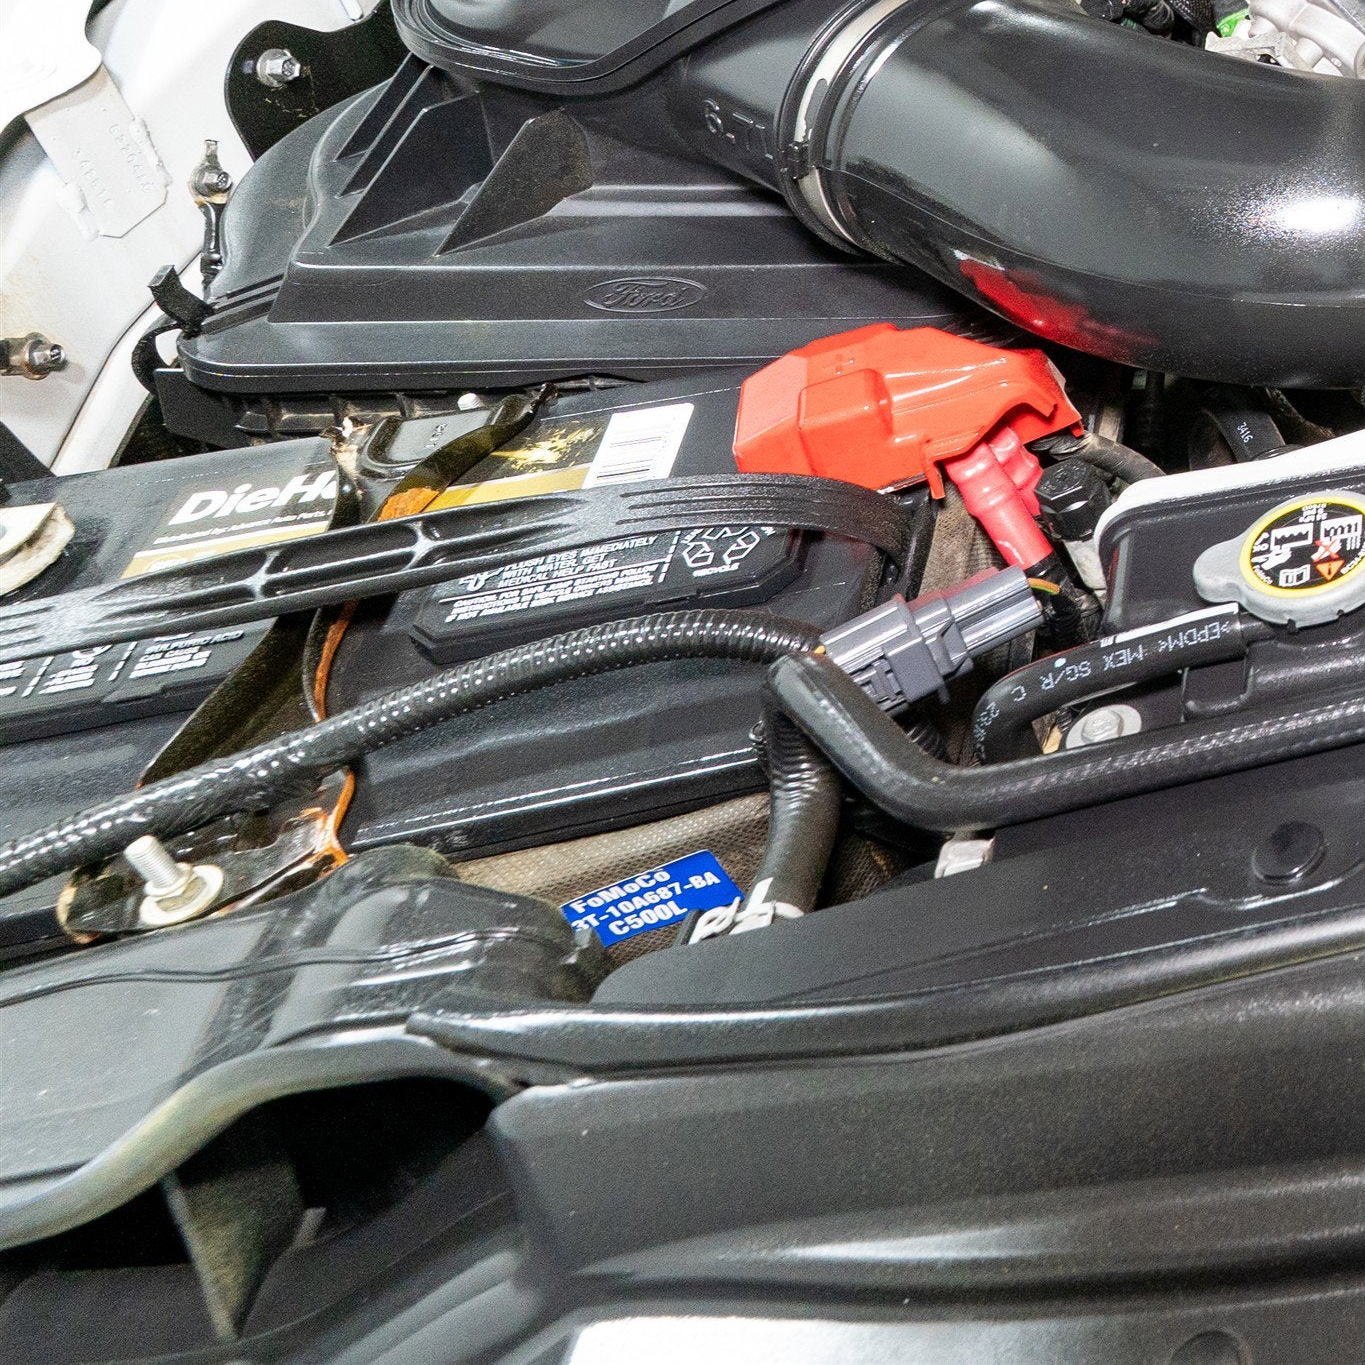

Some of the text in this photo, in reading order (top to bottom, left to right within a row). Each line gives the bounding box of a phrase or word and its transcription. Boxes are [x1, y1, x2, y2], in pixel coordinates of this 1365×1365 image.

[546, 549, 580, 565] EYES
[1103, 644, 1144, 672] MEX
[1011, 685, 1027, 703] C
[570, 869, 671, 914] FoMoCo
[608, 901, 688, 935] C500L
